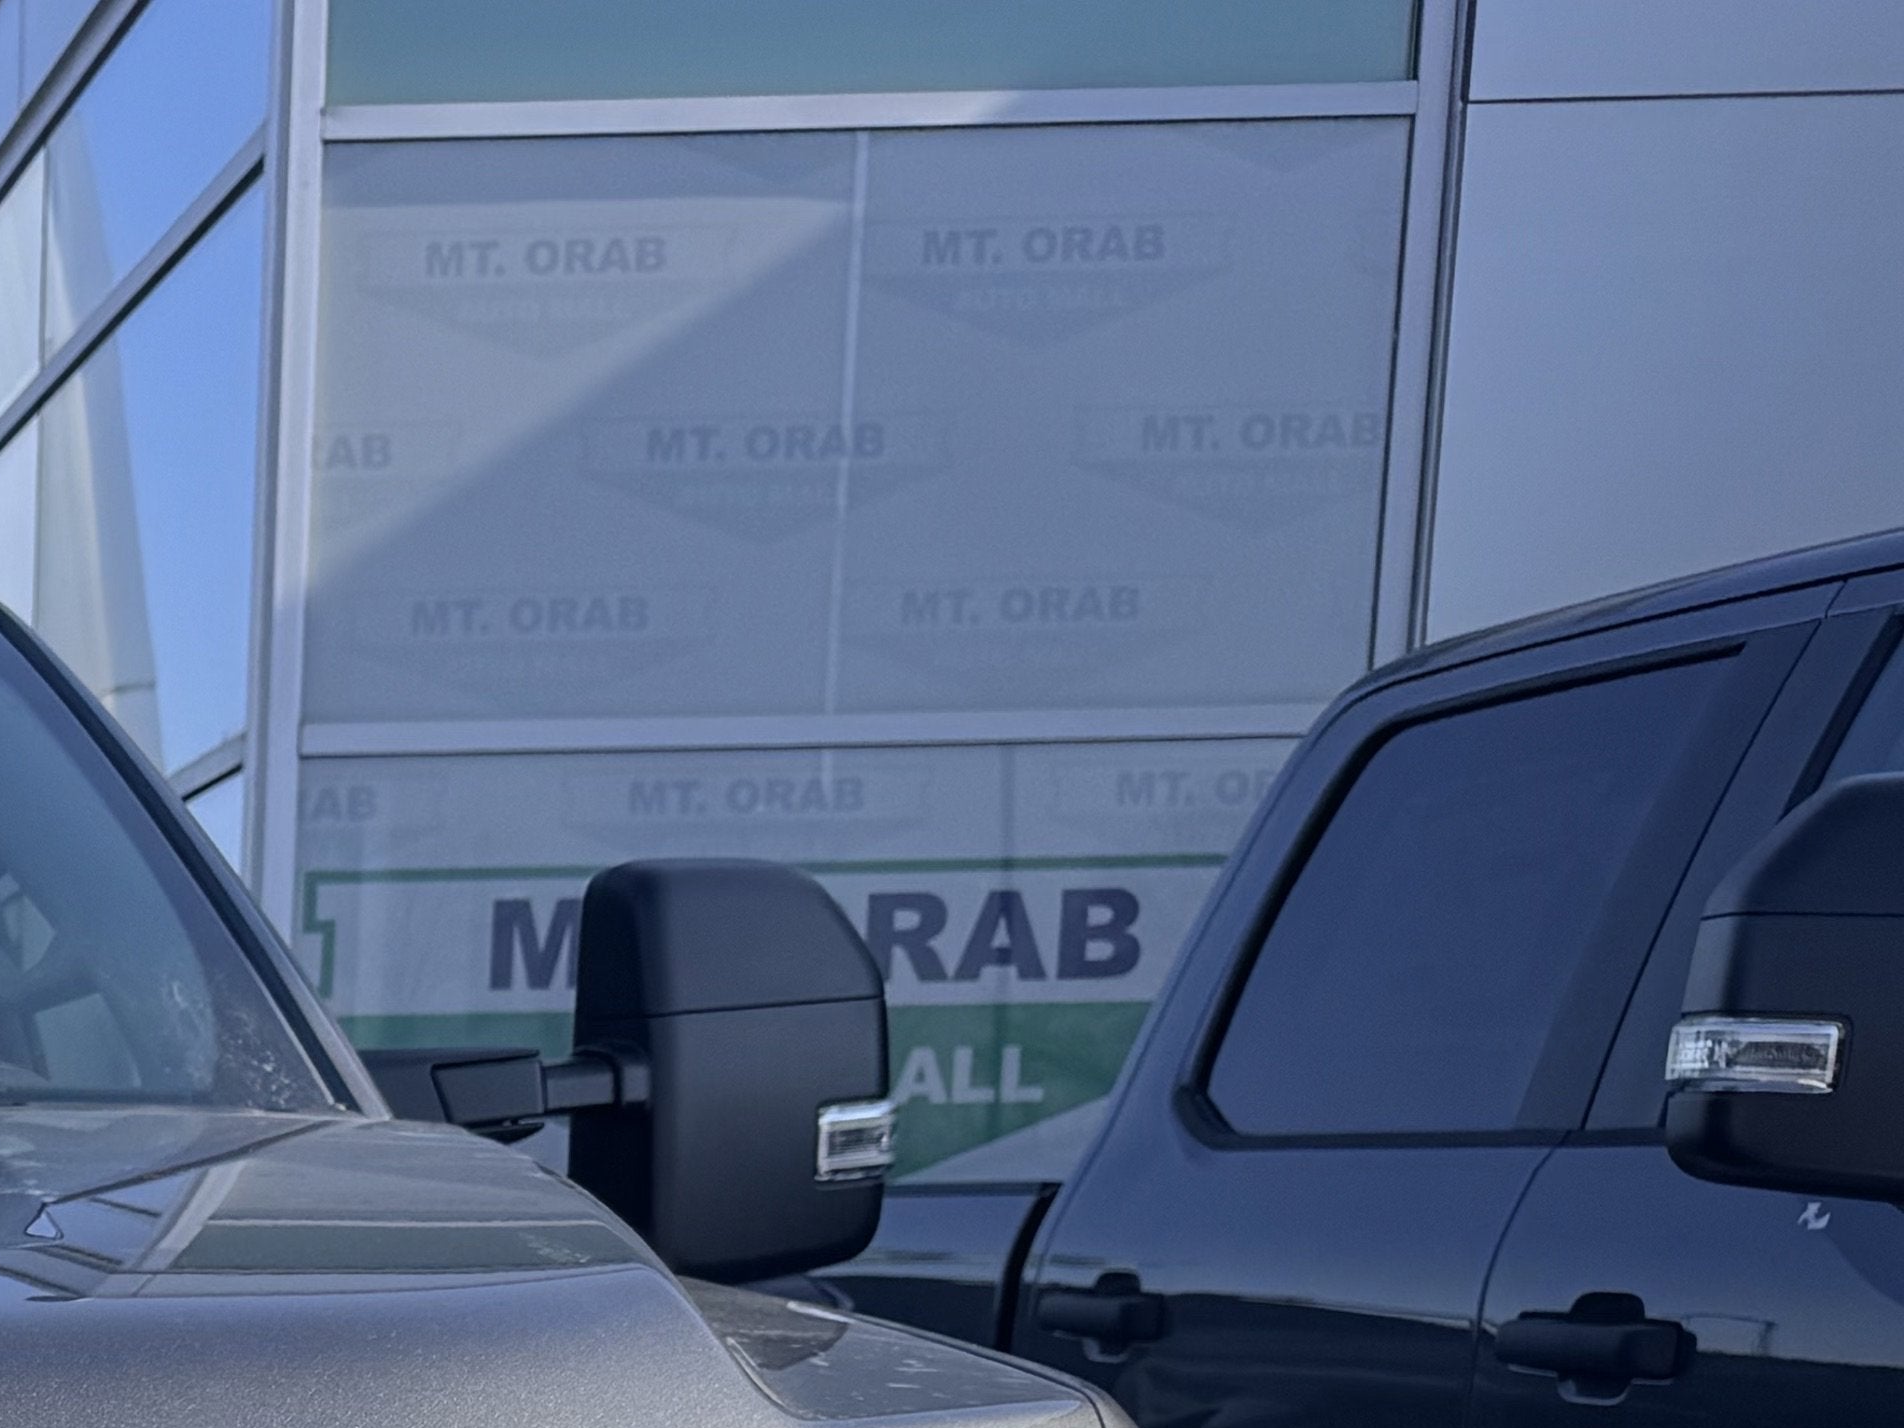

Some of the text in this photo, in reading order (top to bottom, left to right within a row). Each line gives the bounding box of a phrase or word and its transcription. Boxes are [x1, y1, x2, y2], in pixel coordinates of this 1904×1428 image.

[523, 234, 669, 278] ORAB
[1022, 222, 1167, 264] ORAB
[744, 420, 886, 463] ORAB
[1238, 411, 1382, 451] ORAB
[507, 595, 651, 635] ORAB
[998, 584, 1143, 625] ORAB
[725, 775, 866, 814] ORAB
[867, 887, 1141, 983] RAB
[894, 1046, 1045, 1104] ALL
